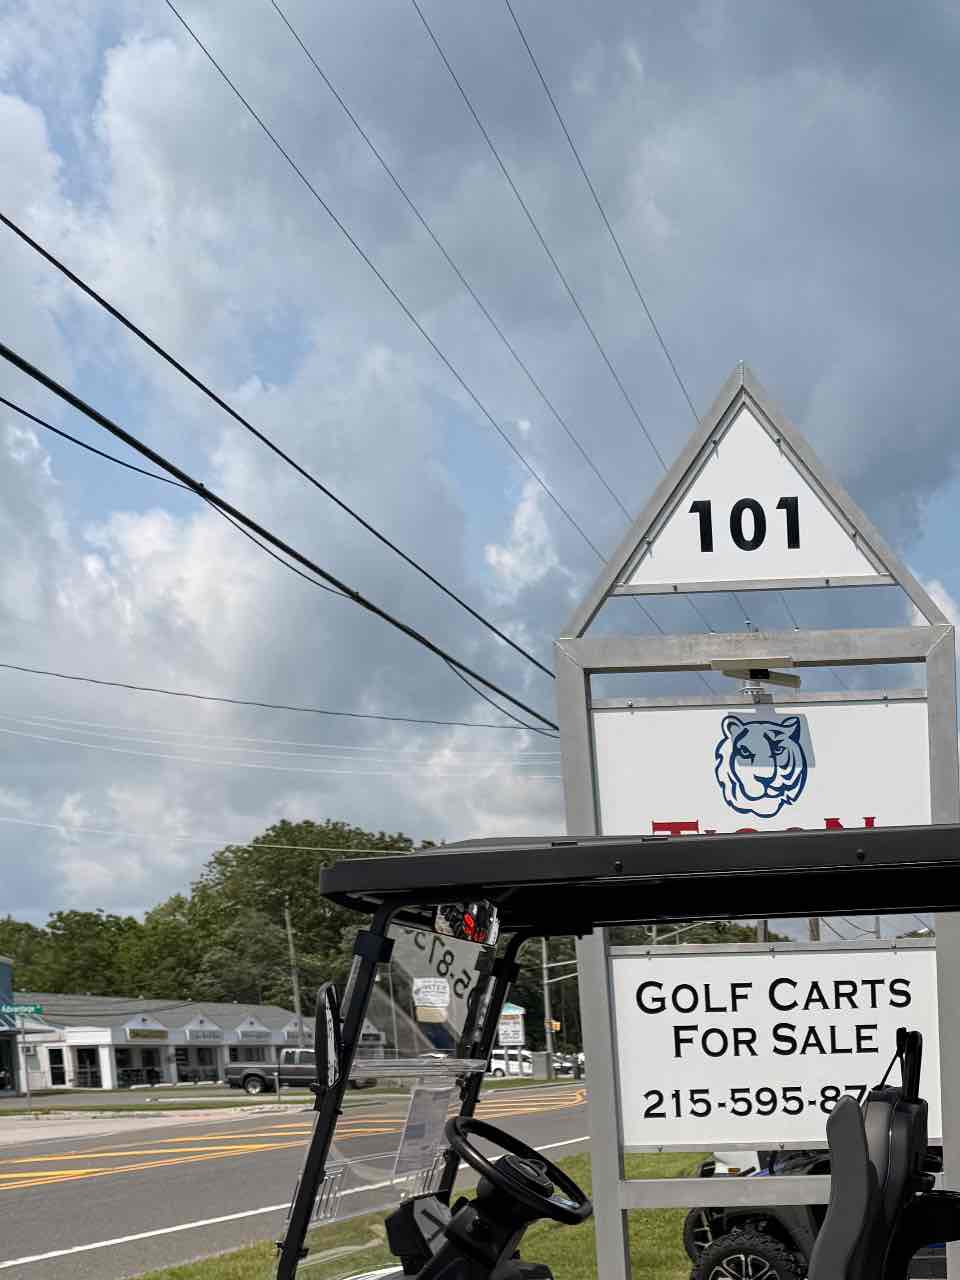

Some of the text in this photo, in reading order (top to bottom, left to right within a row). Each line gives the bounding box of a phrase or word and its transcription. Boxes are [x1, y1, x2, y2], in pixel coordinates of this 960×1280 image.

[688, 496, 801, 553] 101
[636, 977, 912, 1015] GOLF CARTS
[673, 1022, 879, 1058] FOR SALE
